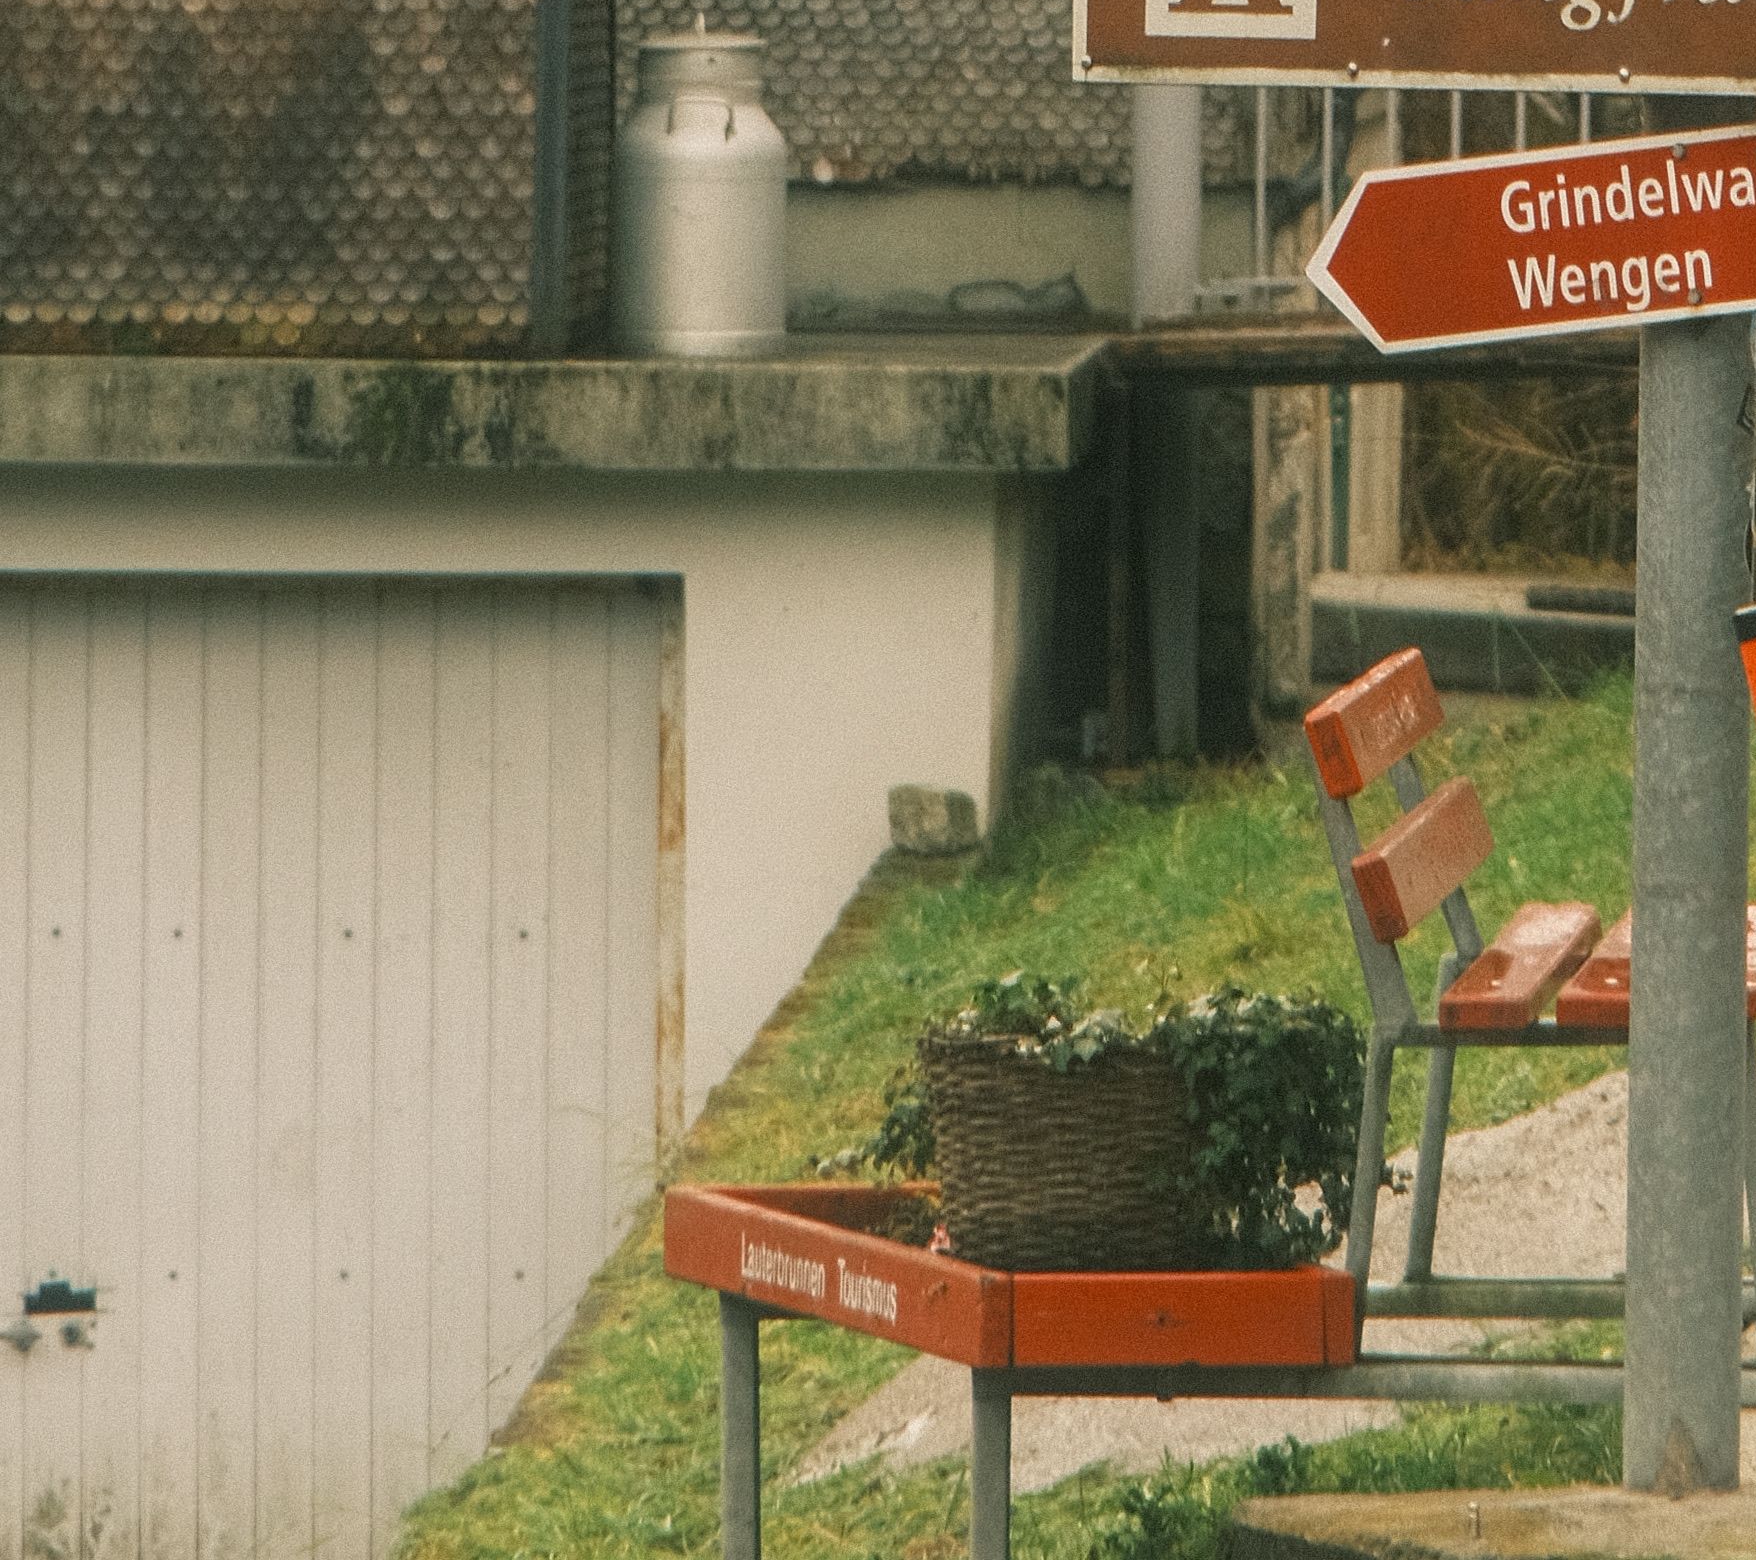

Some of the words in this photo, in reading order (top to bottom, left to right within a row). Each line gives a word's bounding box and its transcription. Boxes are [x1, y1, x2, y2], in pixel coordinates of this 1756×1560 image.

[1507, 244, 1714, 313] Wengen
[741, 1230, 826, 1299] Lauterbrunnen
[837, 1256, 898, 1327] Tourismus
